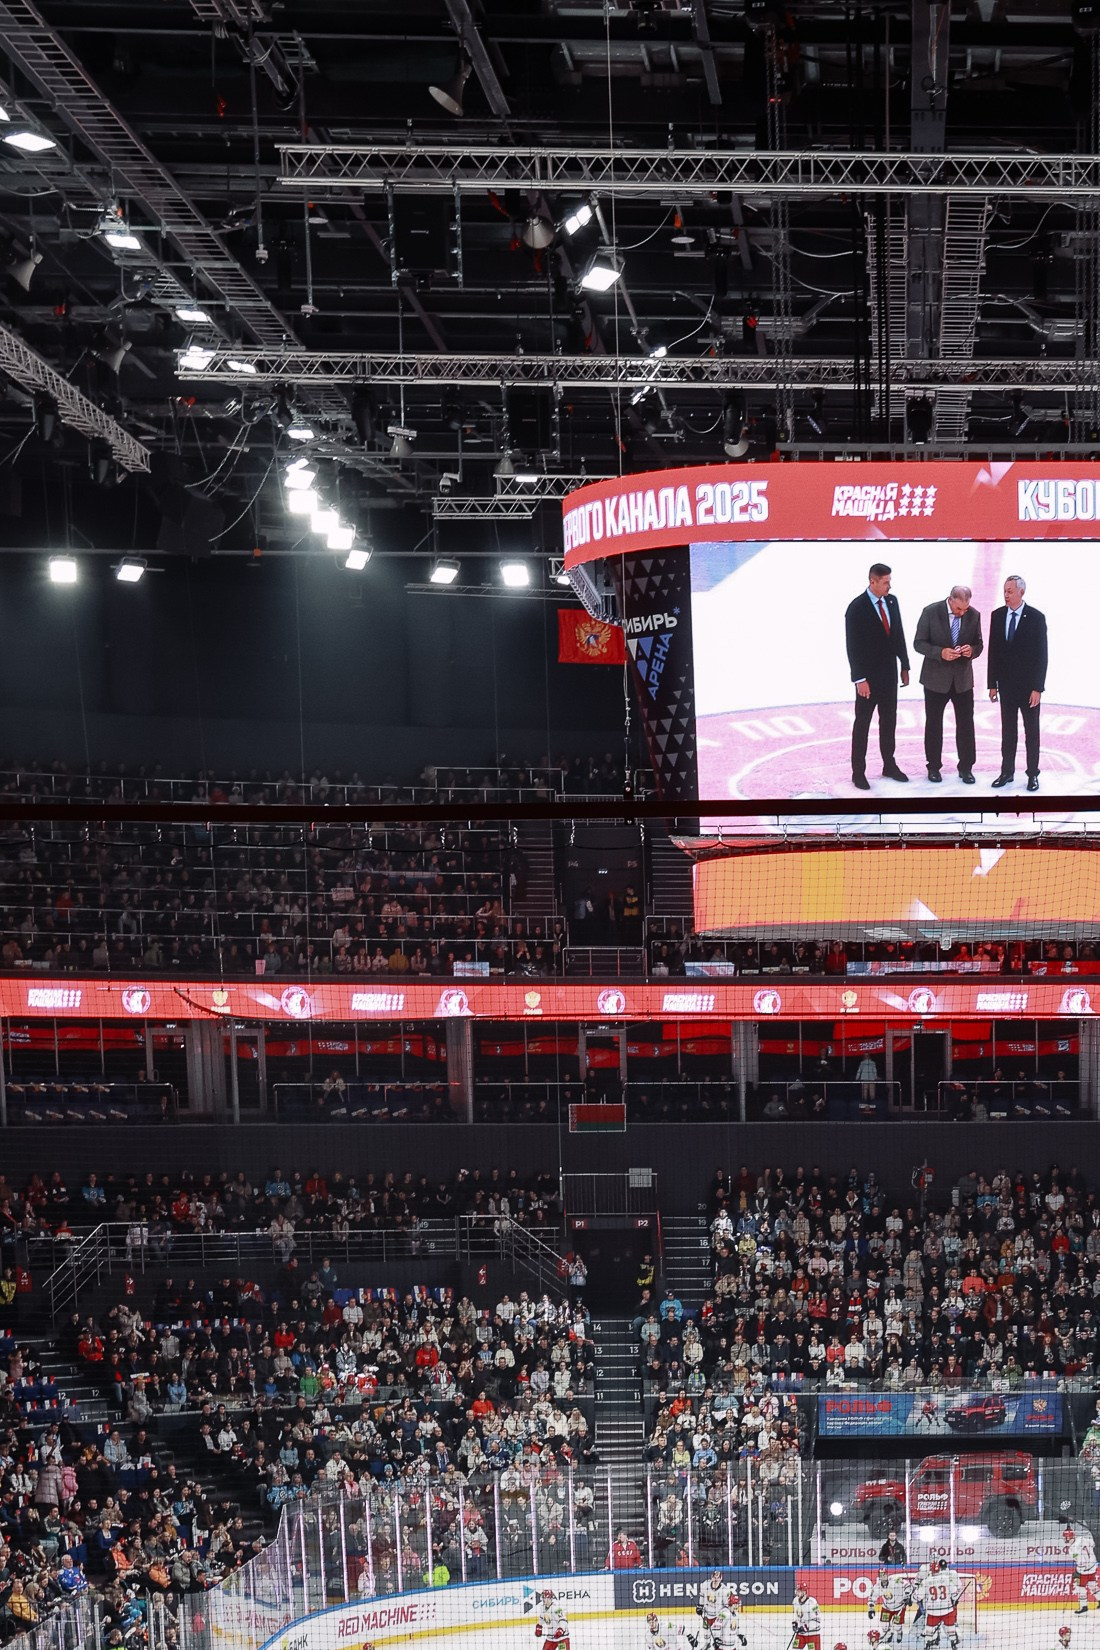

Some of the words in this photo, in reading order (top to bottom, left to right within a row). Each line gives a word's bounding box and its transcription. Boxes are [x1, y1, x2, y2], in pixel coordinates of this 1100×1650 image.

[833, 483, 899, 501] КРАСНАЯ
[606, 485, 693, 538] КАНАЛА
[696, 480, 768, 525] 2025
[647, 633, 673, 700] АРЕНА
[729, 716, 817, 742] ПО
[699, 1239, 709, 1247] 18
[702, 1258, 711, 1266] 17
[703, 1279, 712, 1288] 16
[593, 1323, 602, 1332] 14
[594, 1346, 603, 1355] 13
[630, 1346, 640, 1354] 13
[596, 1369, 605, 1378] 12
[58, 1392, 67, 1401] 12
[596, 1392, 604, 1400] 11
[634, 1392, 641, 1400] 11
[826, 1400, 893, 1414] РОЛЬФ
[917, 1493, 948, 1501] РОЛЬФ
[831, 1548, 877, 1557] РОЛЬФ
[1022, 1574, 1072, 1585] КРАСНАЯ
[660, 1581, 780, 1598] HENRSON
[929, 1586, 947, 1601] 93
[1020, 1585, 1070, 1597] МАШИНА
[473, 1595, 520, 1610] СИБИРЬ
[338, 1616, 361, 1639] RED
[361, 1604, 418, 1633] MACHINE
